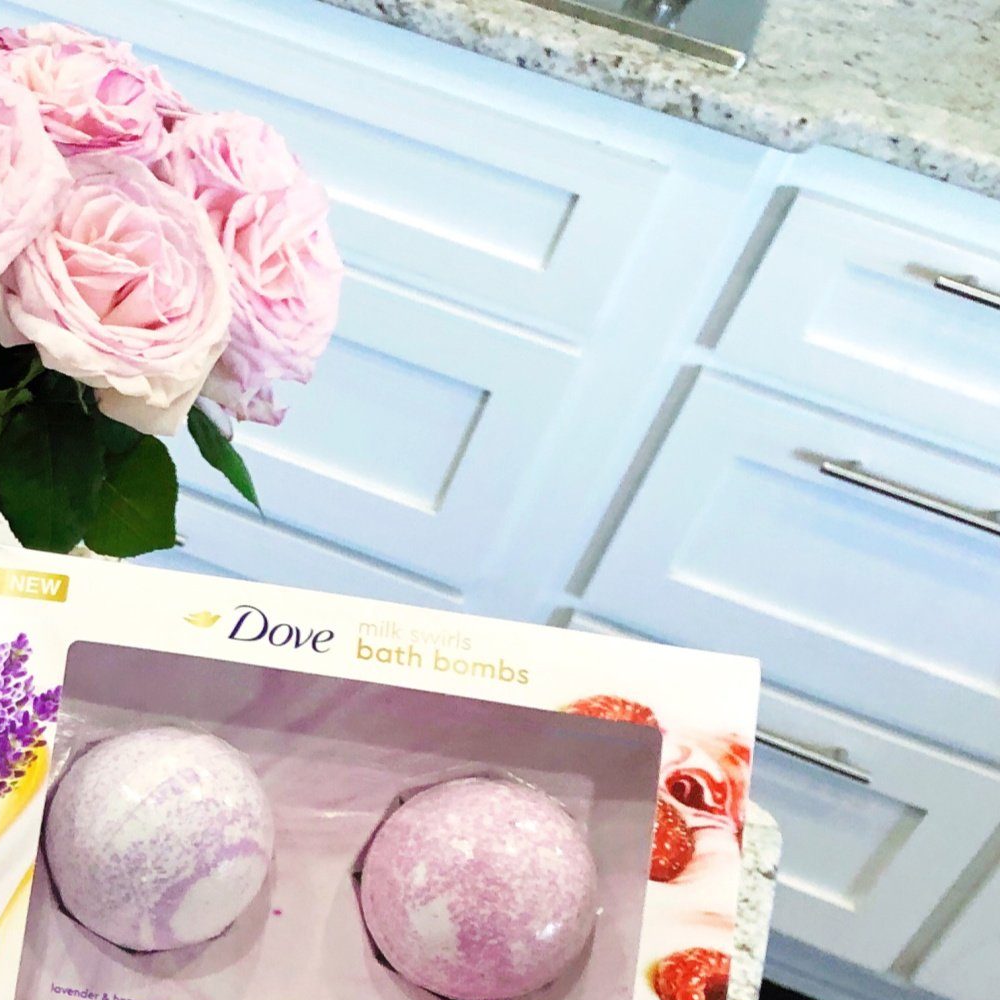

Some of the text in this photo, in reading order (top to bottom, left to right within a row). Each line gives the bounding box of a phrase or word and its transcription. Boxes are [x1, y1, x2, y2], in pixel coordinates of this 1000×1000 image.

[10, 576, 63, 596] NEW
[228, 604, 335, 654] Dove
[358, 620, 473, 651] milk swirls
[357, 638, 530, 686] bath bombs
[50, 983, 99, 1000] lavender
